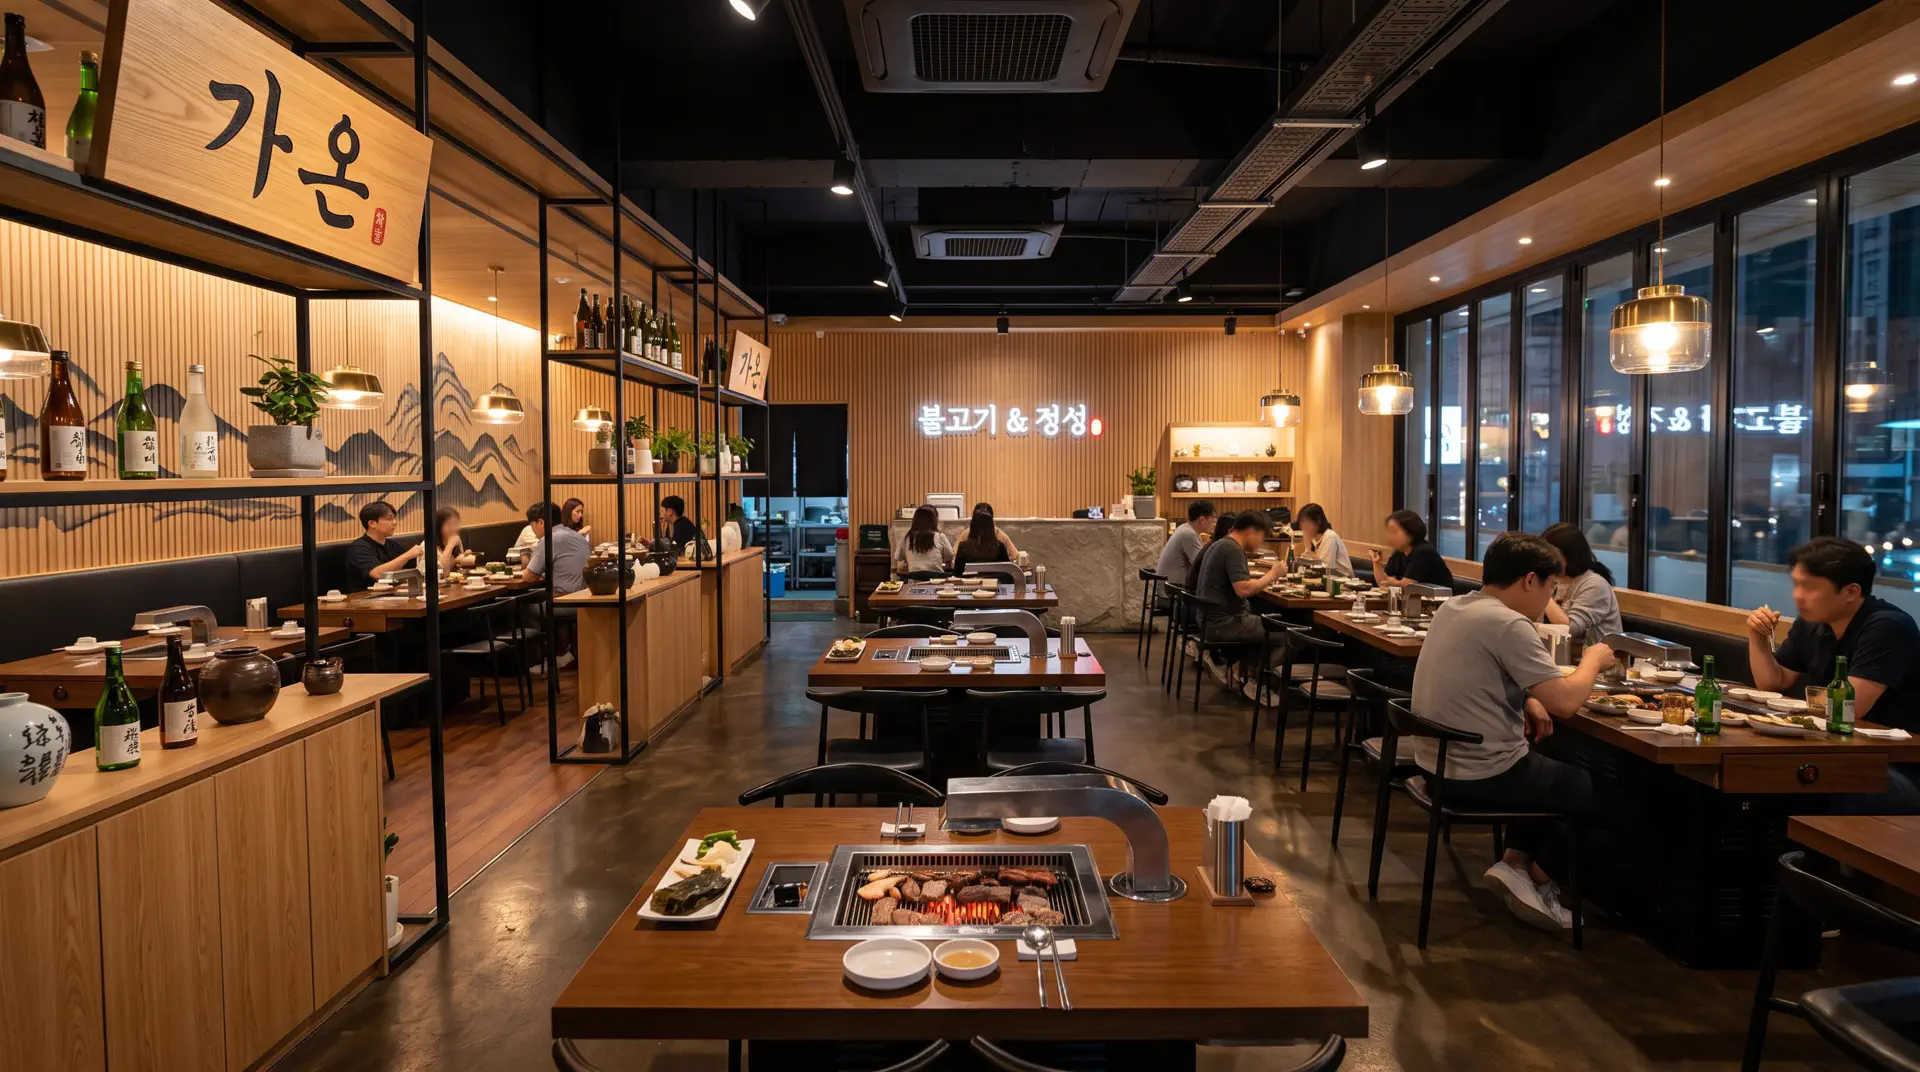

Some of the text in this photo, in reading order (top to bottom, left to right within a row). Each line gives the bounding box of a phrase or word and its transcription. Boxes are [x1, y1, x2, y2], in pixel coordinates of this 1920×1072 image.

[204, 68, 370, 229] 가온
[739, 346, 761, 390] 가온
[918, 403, 1087, 436] 불고기 & 정성
